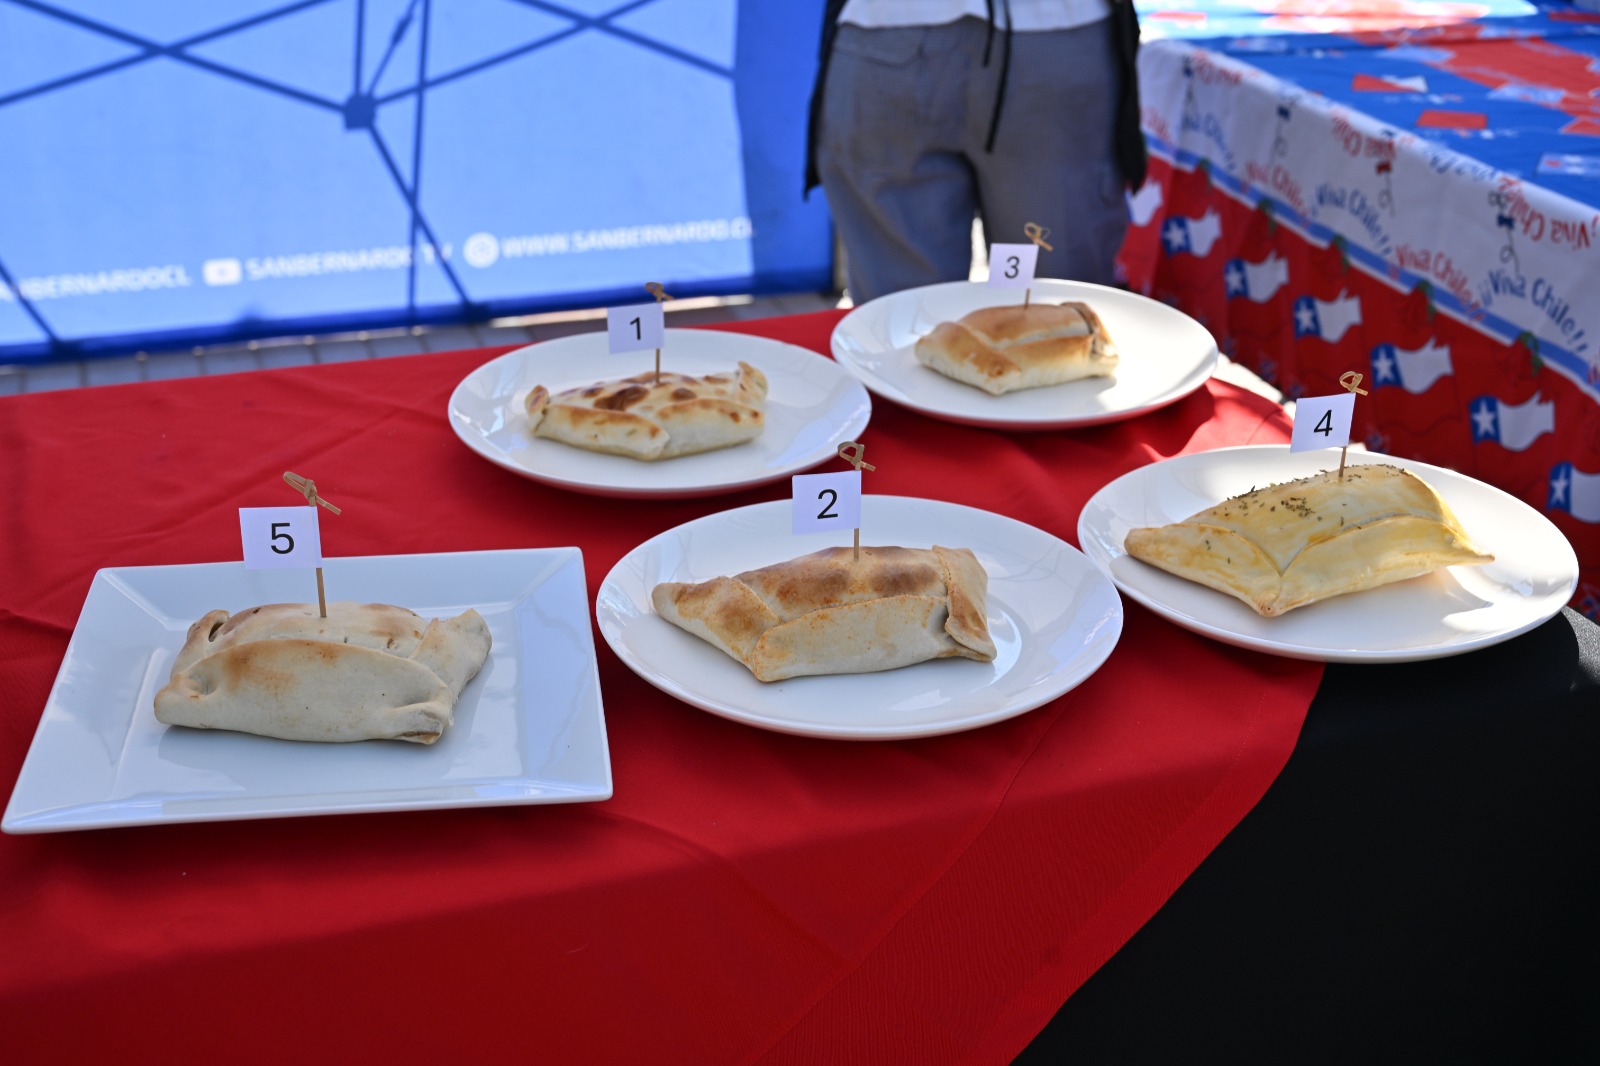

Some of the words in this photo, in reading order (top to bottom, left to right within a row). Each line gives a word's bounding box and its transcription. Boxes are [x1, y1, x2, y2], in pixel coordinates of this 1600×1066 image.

[1004, 256, 1020, 279] 3
[629, 316, 642, 341] 1
[1313, 409, 1333, 437] 4
[816, 488, 839, 520] 2
[270, 522, 295, 555] 5
